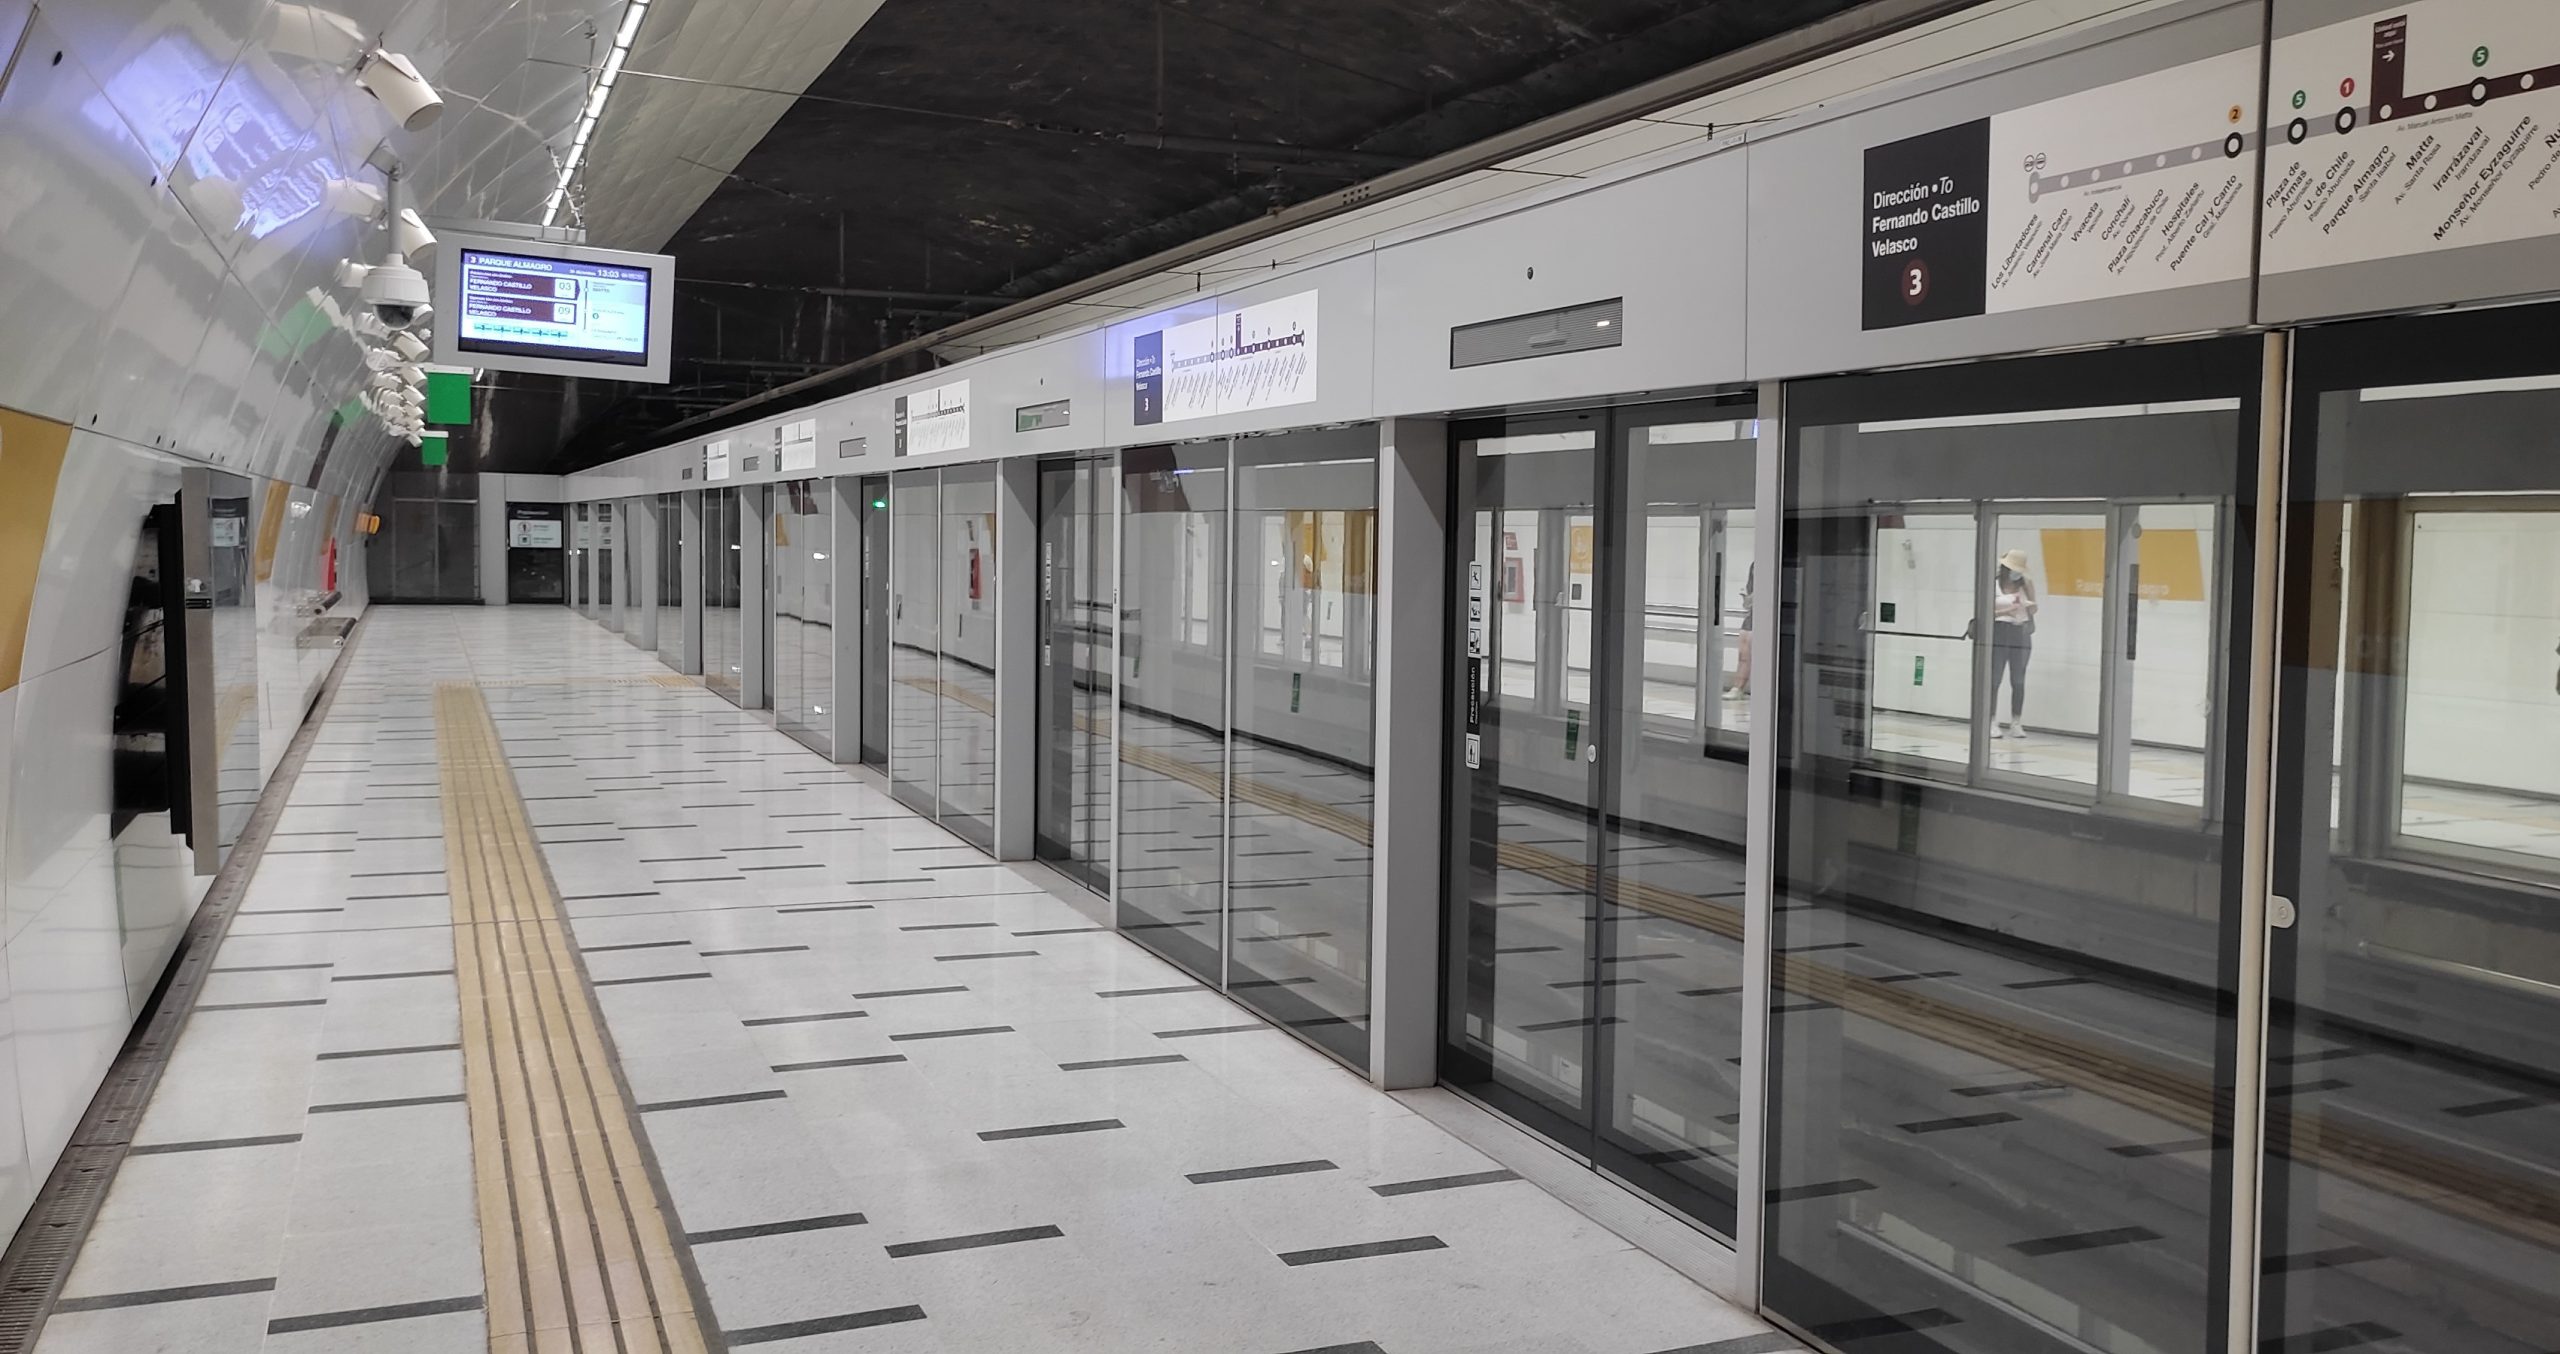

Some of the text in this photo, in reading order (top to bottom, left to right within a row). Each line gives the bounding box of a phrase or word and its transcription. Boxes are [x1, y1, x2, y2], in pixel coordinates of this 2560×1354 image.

[2475, 49, 2485, 63] 5
[2231, 108, 2239, 121] 2
[2294, 91, 2304, 106] 5
[2405, 134, 2436, 171] Matta
[1873, 176, 1954, 210] Dirección To
[2265, 161, 2300, 208] Plaza de
[2280, 169, 2308, 207] Armas
[2303, 151, 2349, 211] U. de Chile
[2322, 145, 2389, 235] Parque Almagro
[2432, 115, 2532, 241] Monseñor Eyzaguirre
[1872, 196, 1980, 234] Fernando Castillo
[2070, 201, 2100, 243] Vivaceta
[2100, 193, 2131, 241] Conchalí
[2161, 181, 2200, 237] Hospitales
[2170, 235, 2197, 272] Puente
[2194, 214, 2208, 234] Cal
[2212, 174, 2237, 207] Canto
[1871, 237, 1918, 258] Velasco
[2025, 208, 2069, 274] Cardenal Caro
[2107, 188, 2164, 273] Plaza Chacabuco
[478, 257, 513, 267] PARQUE
[1990, 213, 2039, 290] Los Libertadores
[559, 281, 572, 291] 03
[1909, 268, 1922, 296] 3
[558, 306, 571, 315] 09
